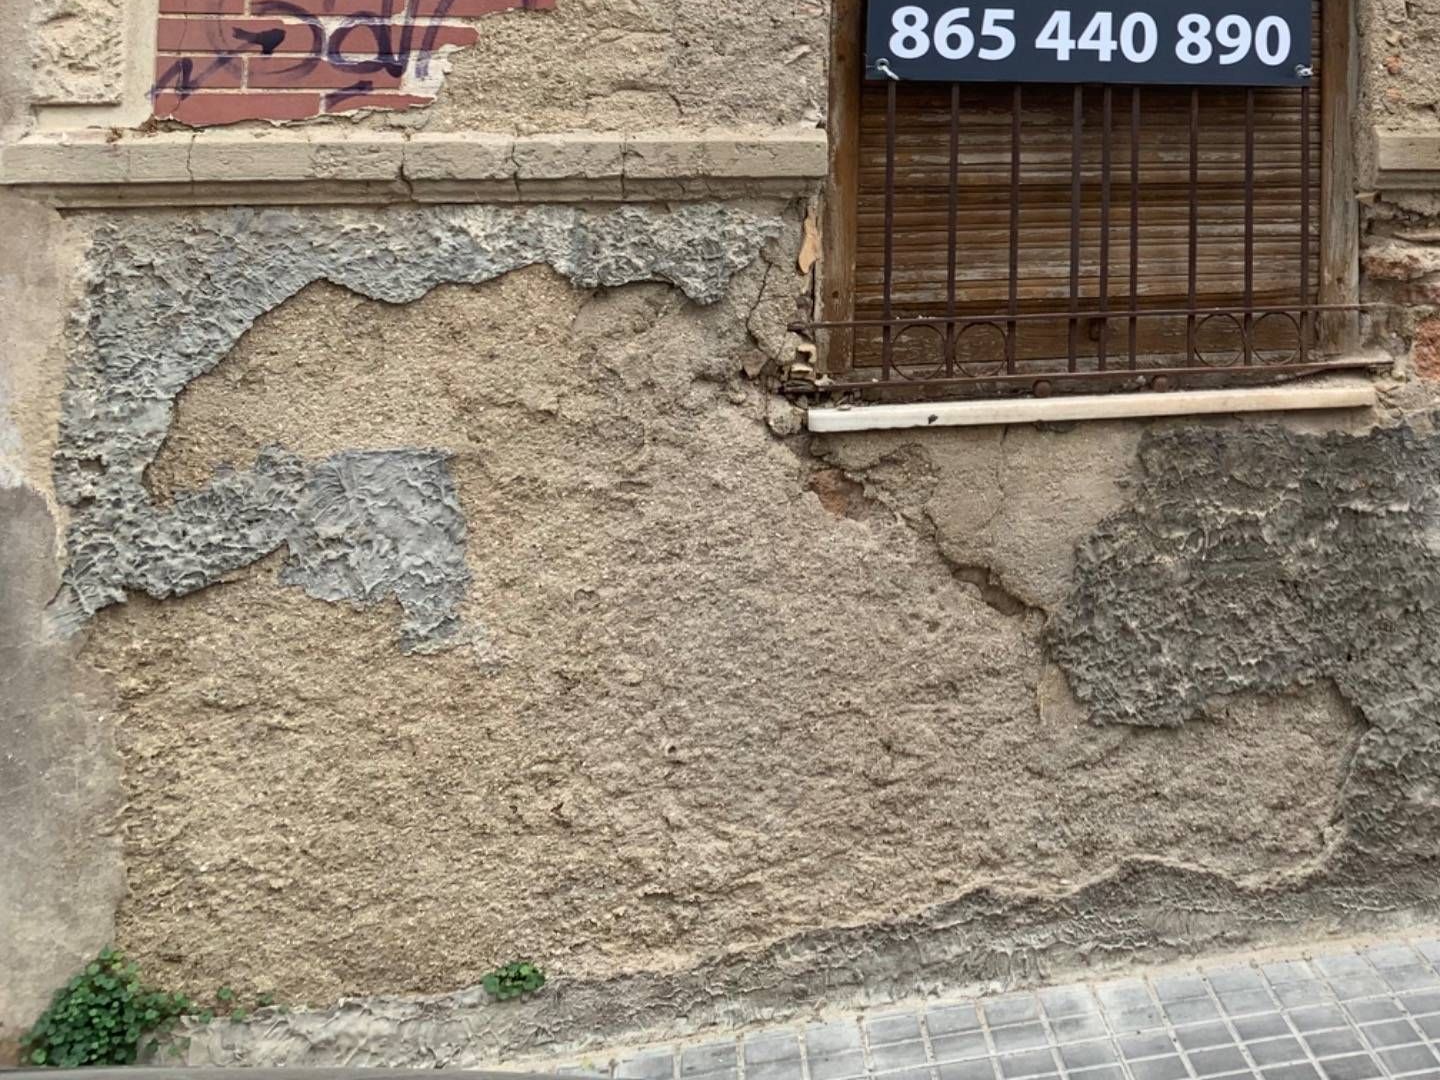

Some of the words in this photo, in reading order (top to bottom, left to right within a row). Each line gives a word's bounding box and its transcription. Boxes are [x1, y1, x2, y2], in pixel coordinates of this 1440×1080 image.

[888, 6, 1017, 61] 865
[1035, 9, 1158, 62] 440
[1174, 12, 1292, 66] 890
